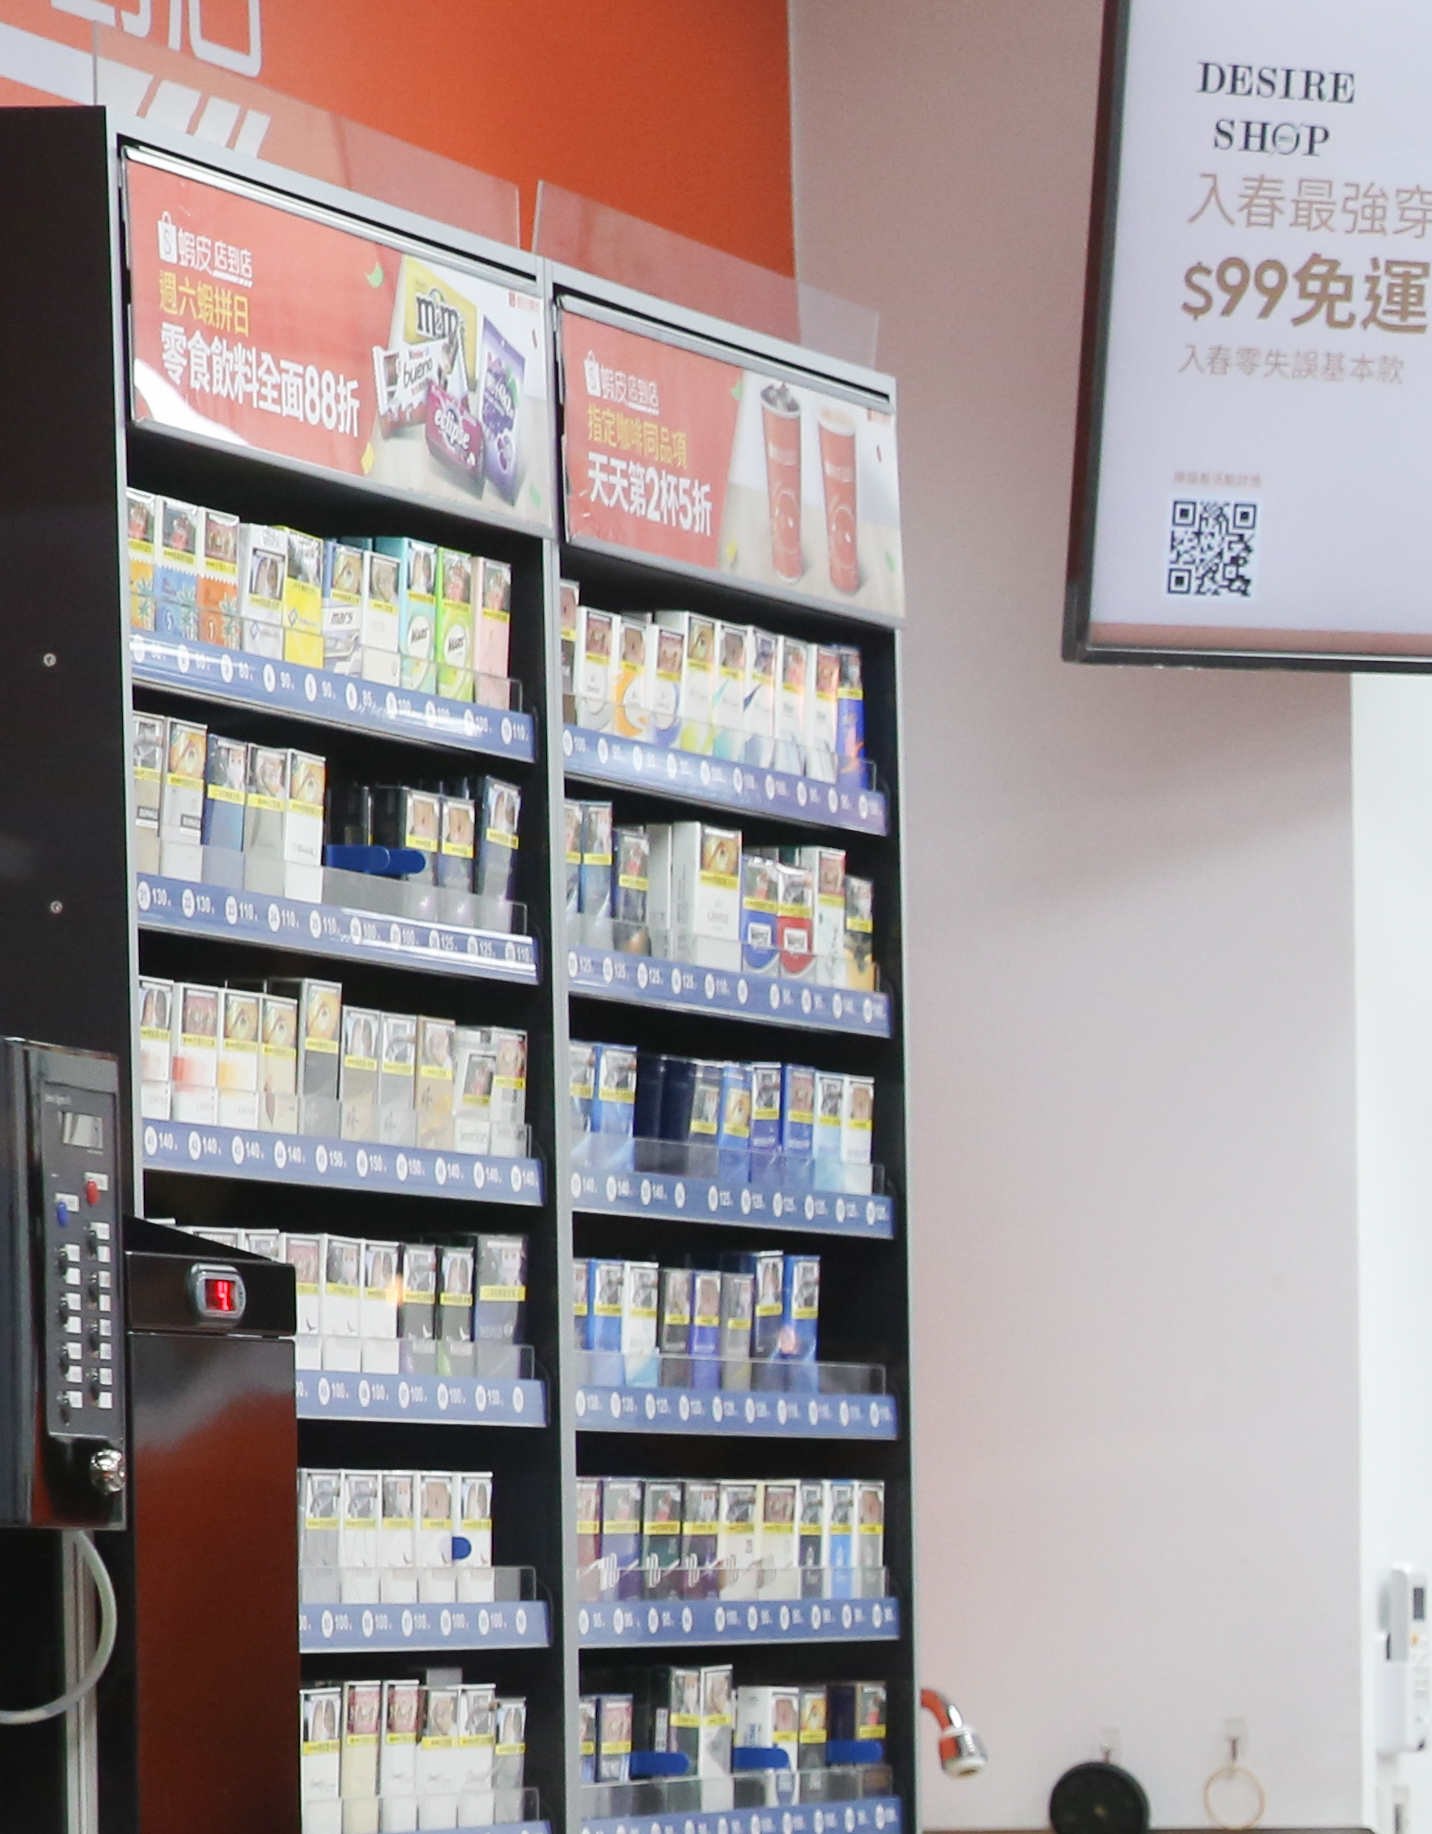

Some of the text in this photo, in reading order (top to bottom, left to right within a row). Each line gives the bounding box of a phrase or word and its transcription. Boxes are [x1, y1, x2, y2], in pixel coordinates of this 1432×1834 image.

[1198, 62, 1355, 103] DESIRE
[1214, 120, 1330, 157] SHOP
[160, 270, 249, 336] 週六蝦拼日
[161, 322, 360, 437] 零食飲料全面88折
[403, 357, 432, 389] bueno
[1179, 344, 1404, 385] 入春零失誤基本款
[588, 451, 712, 536] 天天第2杯5折
